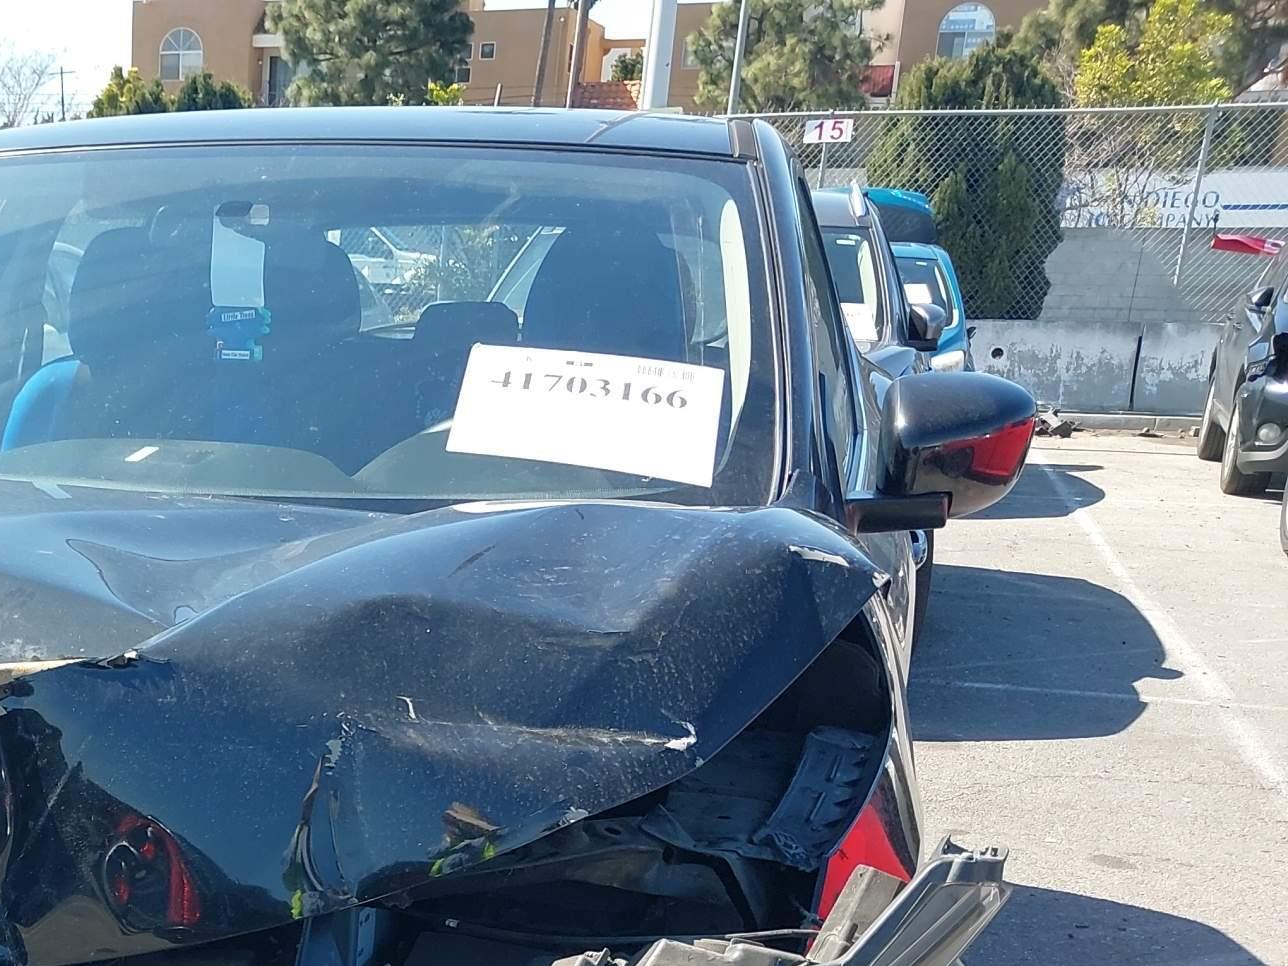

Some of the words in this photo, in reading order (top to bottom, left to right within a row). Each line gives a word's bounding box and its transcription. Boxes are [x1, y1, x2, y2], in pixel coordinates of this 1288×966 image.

[814, 120, 844, 140] 15
[1144, 191, 1220, 208] DIEGO
[490, 371, 688, 409] 41703166
